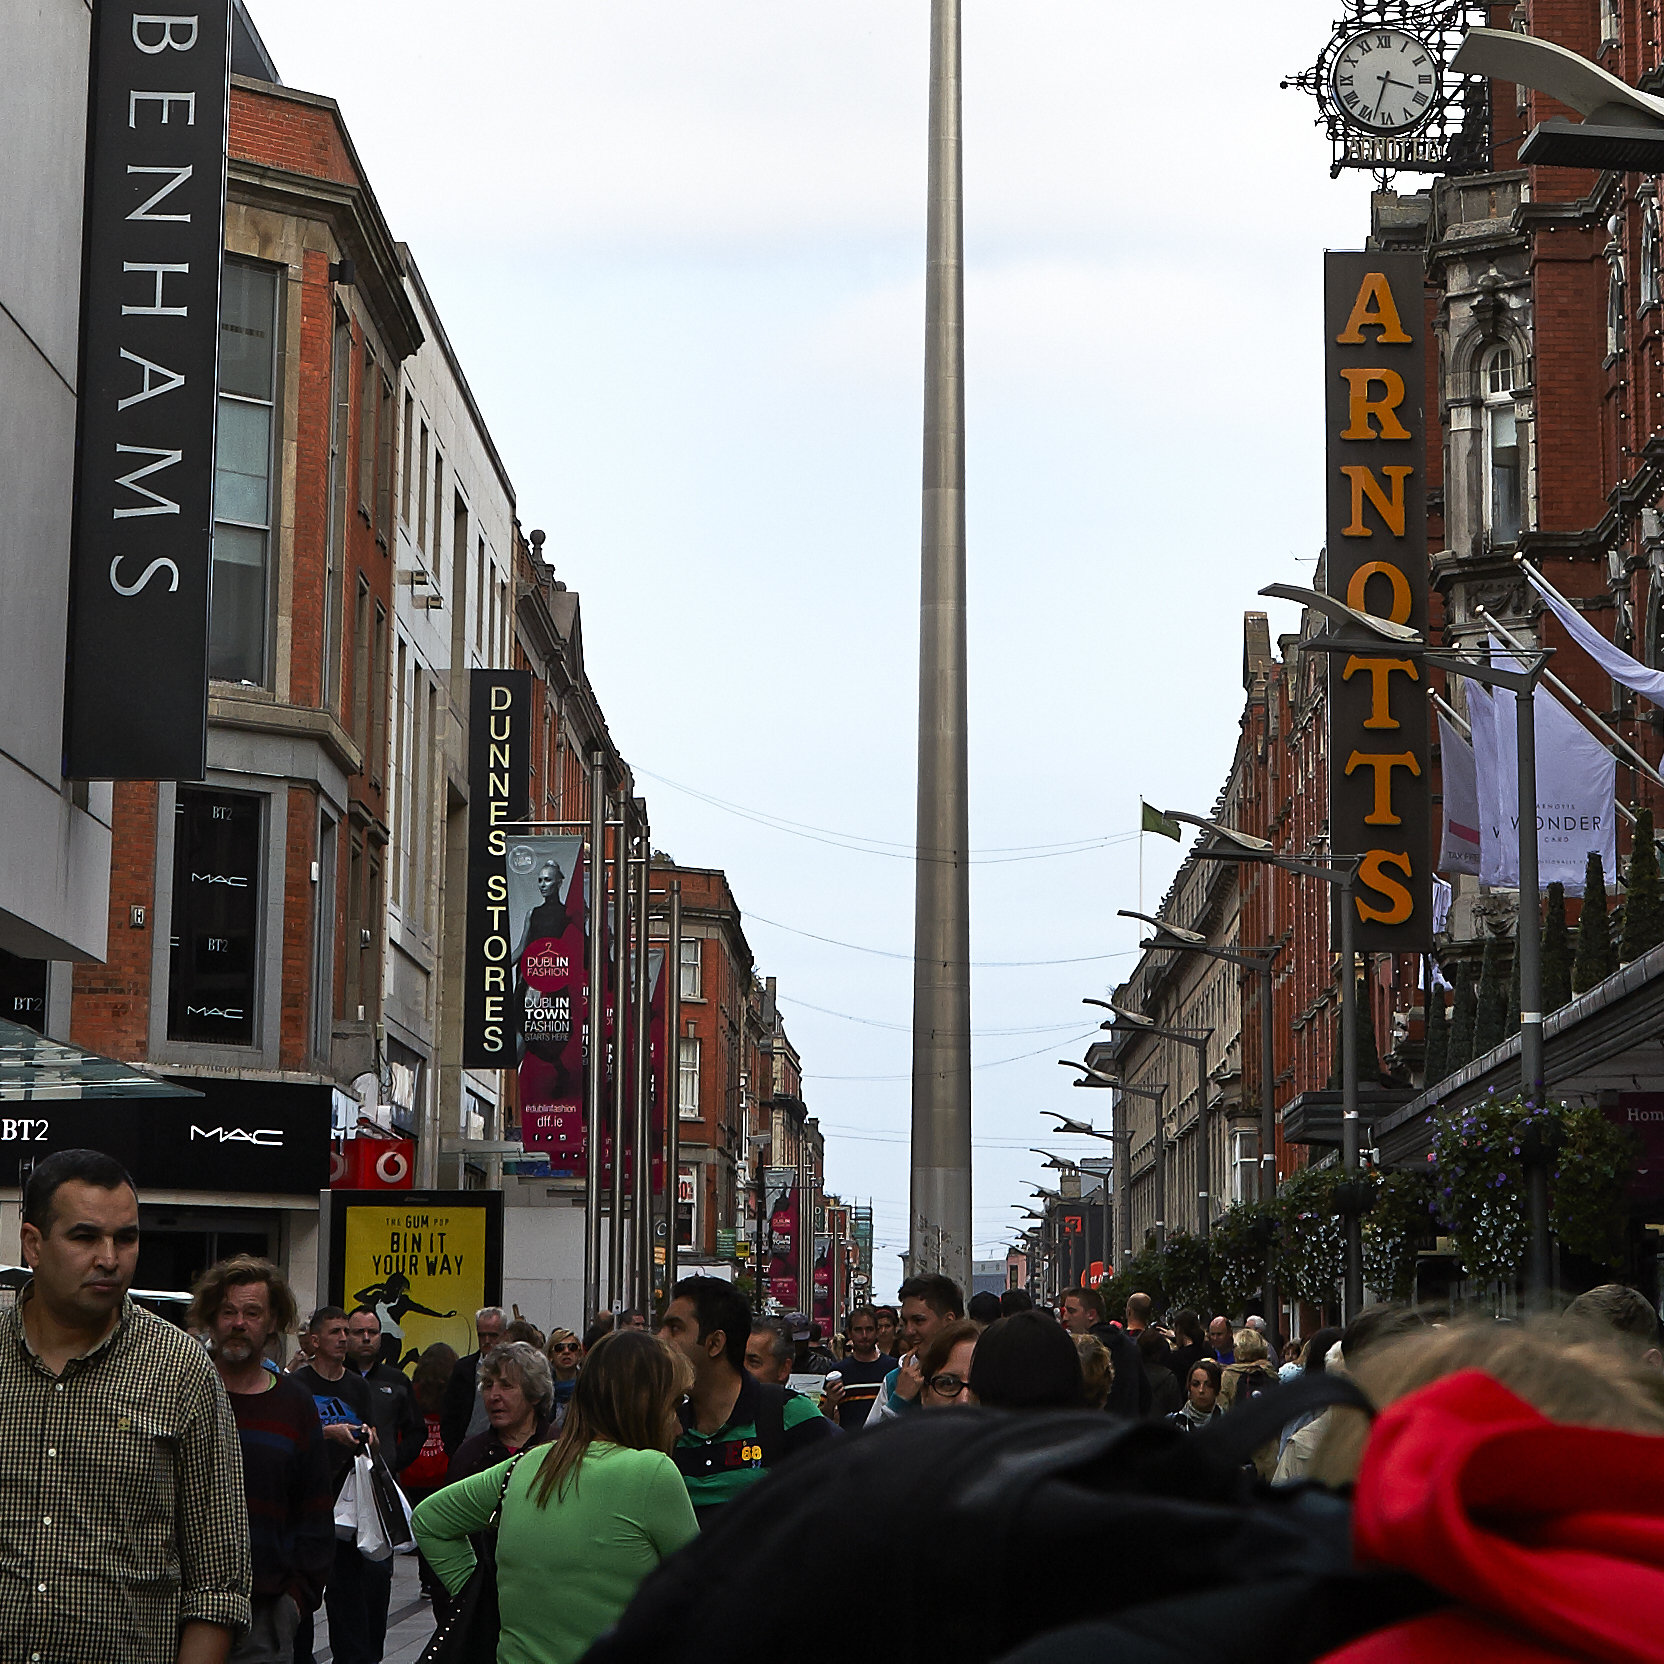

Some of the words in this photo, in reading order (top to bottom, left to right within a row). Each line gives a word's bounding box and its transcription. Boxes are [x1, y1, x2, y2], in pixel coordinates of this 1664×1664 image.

[1337, 272, 1422, 925] ARNOTTS
[487, 686, 513, 856] DUNNES
[212, 806, 232, 821] BT2
[207, 938, 228, 953] BT2
[482, 875, 508, 1053] STORES
[527, 956, 569, 968] DUBLIN
[527, 967, 569, 977] FASHION
[13, 996, 43, 1011] BT2
[524, 997, 569, 1008] DUBLIN
[524, 1008, 569, 1020] TOWN
[524, 1020, 569, 1032] FASHION
[525, 1033, 550, 1042] STARTS
[551, 1033, 569, 1041] HERE
[537, 1115, 563, 1128] dff.ie
[1, 1119, 49, 1141] BT2
[386, 1217, 401, 1227] THE
[405, 1215, 429, 1229] GUM
[390, 1231, 422, 1254] BIN
[429, 1232, 447, 1254] IT
[372, 1254, 418, 1276] YOUR
[425, 1253, 463, 1276] WAY
